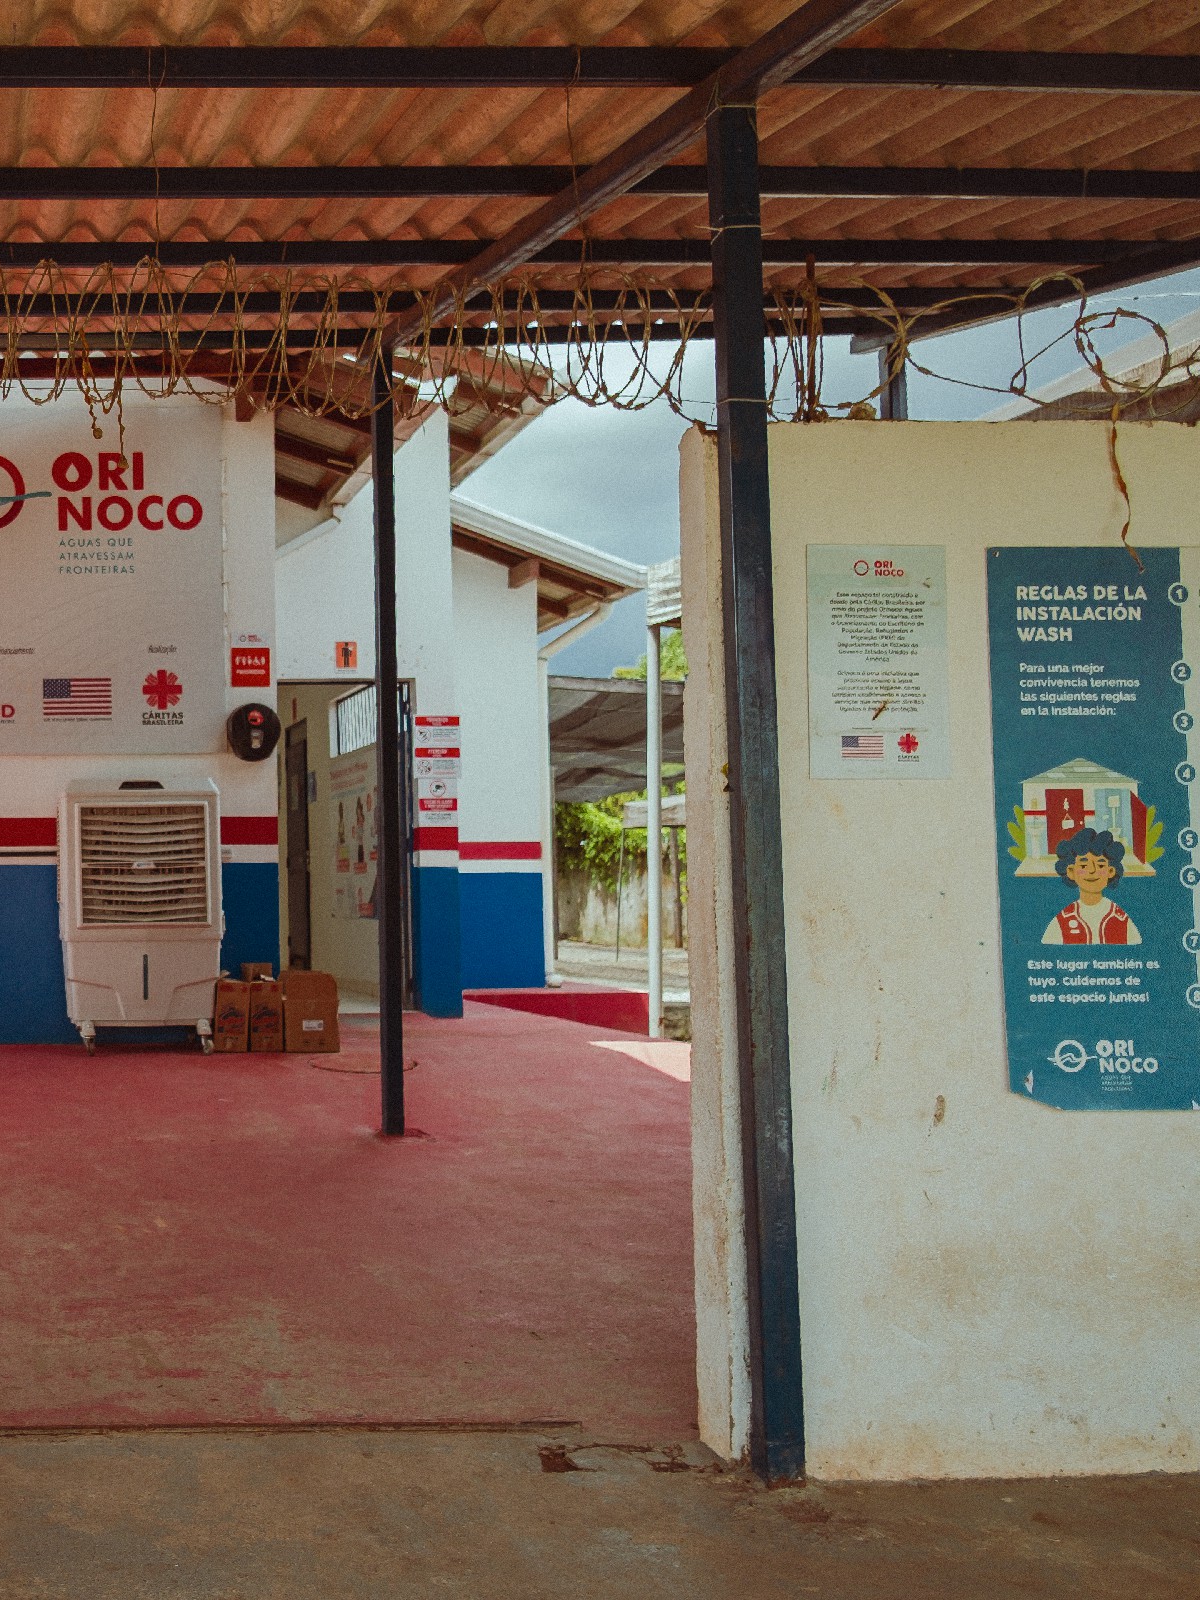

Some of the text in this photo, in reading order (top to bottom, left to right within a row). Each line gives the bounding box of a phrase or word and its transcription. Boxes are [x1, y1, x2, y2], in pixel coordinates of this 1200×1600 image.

[52, 452, 145, 492] ORI
[58, 495, 203, 531] NOCO
[107, 538, 134, 548] QUE
[59, 552, 135, 561] ATRAVESSAM
[874, 560, 893, 569] ORI
[59, 566, 135, 575] FRONTEIRAS
[874, 569, 905, 577] NOCO
[1016, 585, 1147, 601] REGLAS DE LA
[1175, 589, 1183, 599] 1
[1016, 603, 1142, 621] INSTALACIÓN
[1016, 627, 1072, 641] WASH
[1019, 662, 1045, 673] Para
[1072, 662, 1104, 675] mejor
[1178, 667, 1186, 677] 2
[1019, 677, 1140, 688] convivencia tenemos
[1020, 692, 1136, 704] las siguientes reglas
[142, 710, 184, 719] CÁRITAS
[1038, 706, 1049, 715] la
[1180, 717, 1188, 727] 3
[1182, 768, 1190, 778] 4
[1185, 834, 1193, 845] 5
[1187, 871, 1195, 882] 6
[1190, 935, 1197, 947] 7
[1027, 959, 1053, 970] Este
[1056, 959, 1089, 972] lugar
[1092, 959, 1142, 970] también
[1027, 976, 1141, 988] tuyo. Cuidemos de
[1029, 992, 1150, 1004] este espacio juntos!
[1096, 1039, 1134, 1057] ORI
[1099, 1058, 1159, 1073] NOCO
